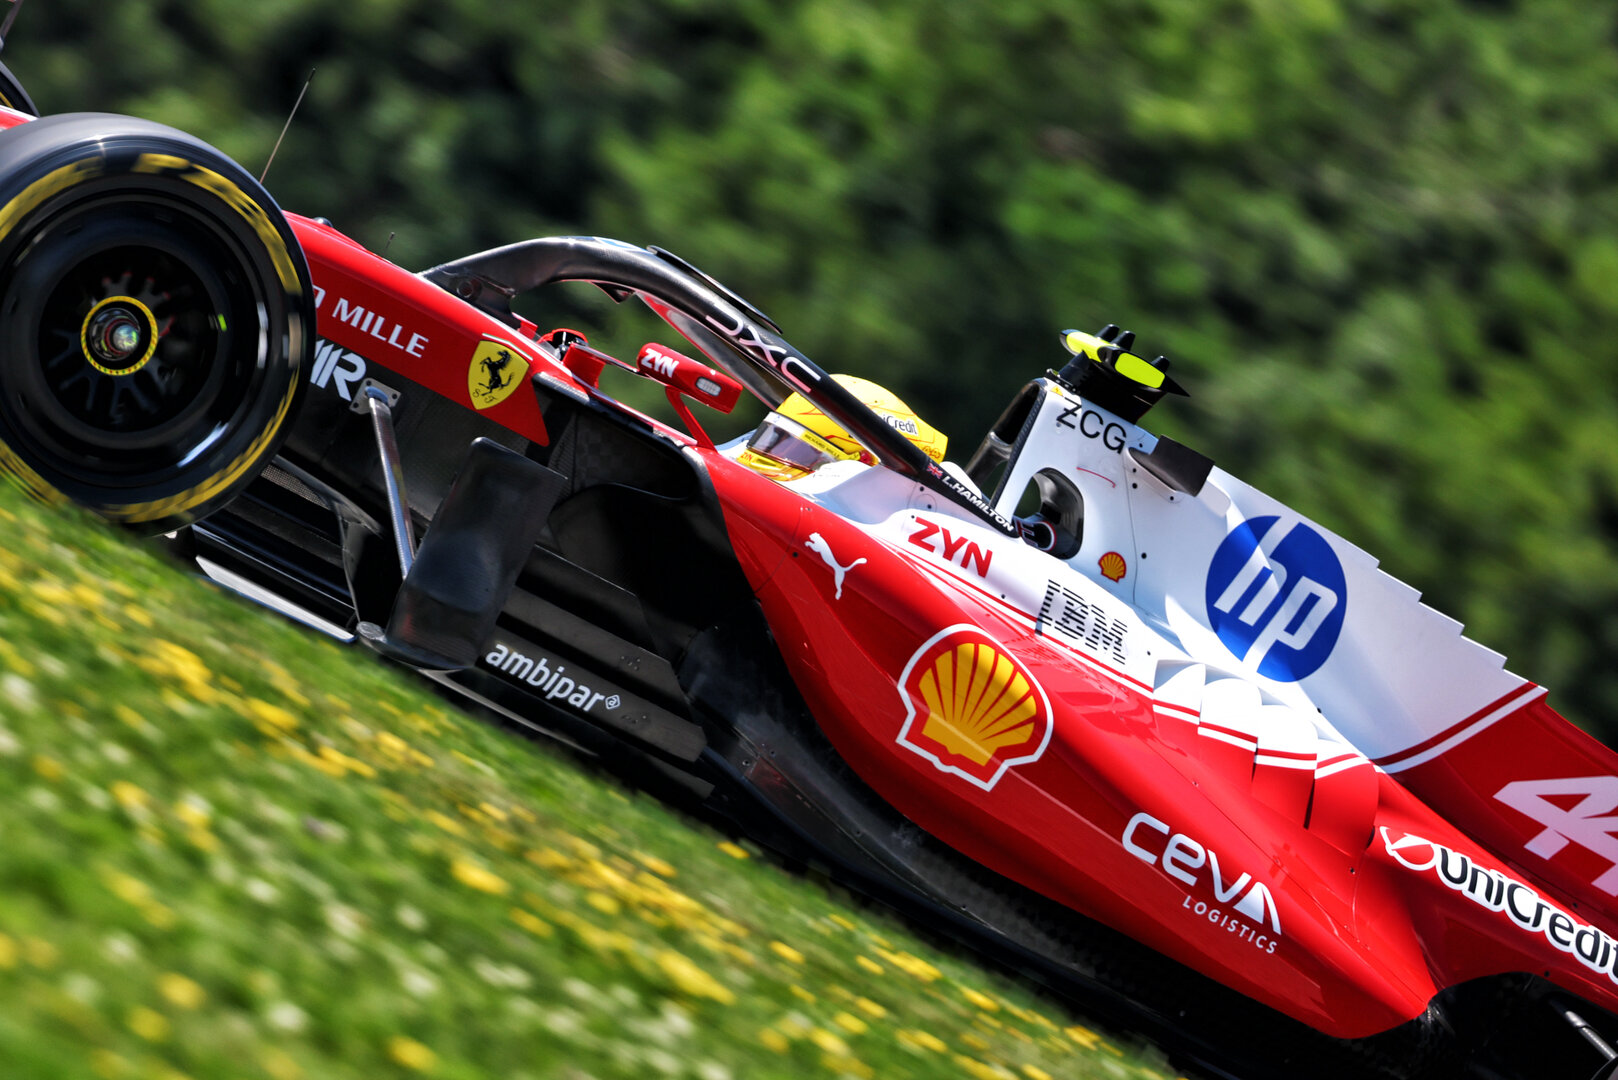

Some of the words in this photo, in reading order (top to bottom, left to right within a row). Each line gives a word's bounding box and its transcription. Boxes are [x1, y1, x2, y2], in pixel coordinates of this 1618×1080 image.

[332, 297, 430, 358] MILLE
[705, 302, 822, 393] DXC
[640, 347, 680, 378] ZYN
[908, 516, 993, 579] ZYN
[1038, 579, 1128, 665] IBM
[1213, 516, 1338, 673] hp
[485, 643, 606, 712] ambipar
[1182, 895, 1278, 954] LOGISTICS
